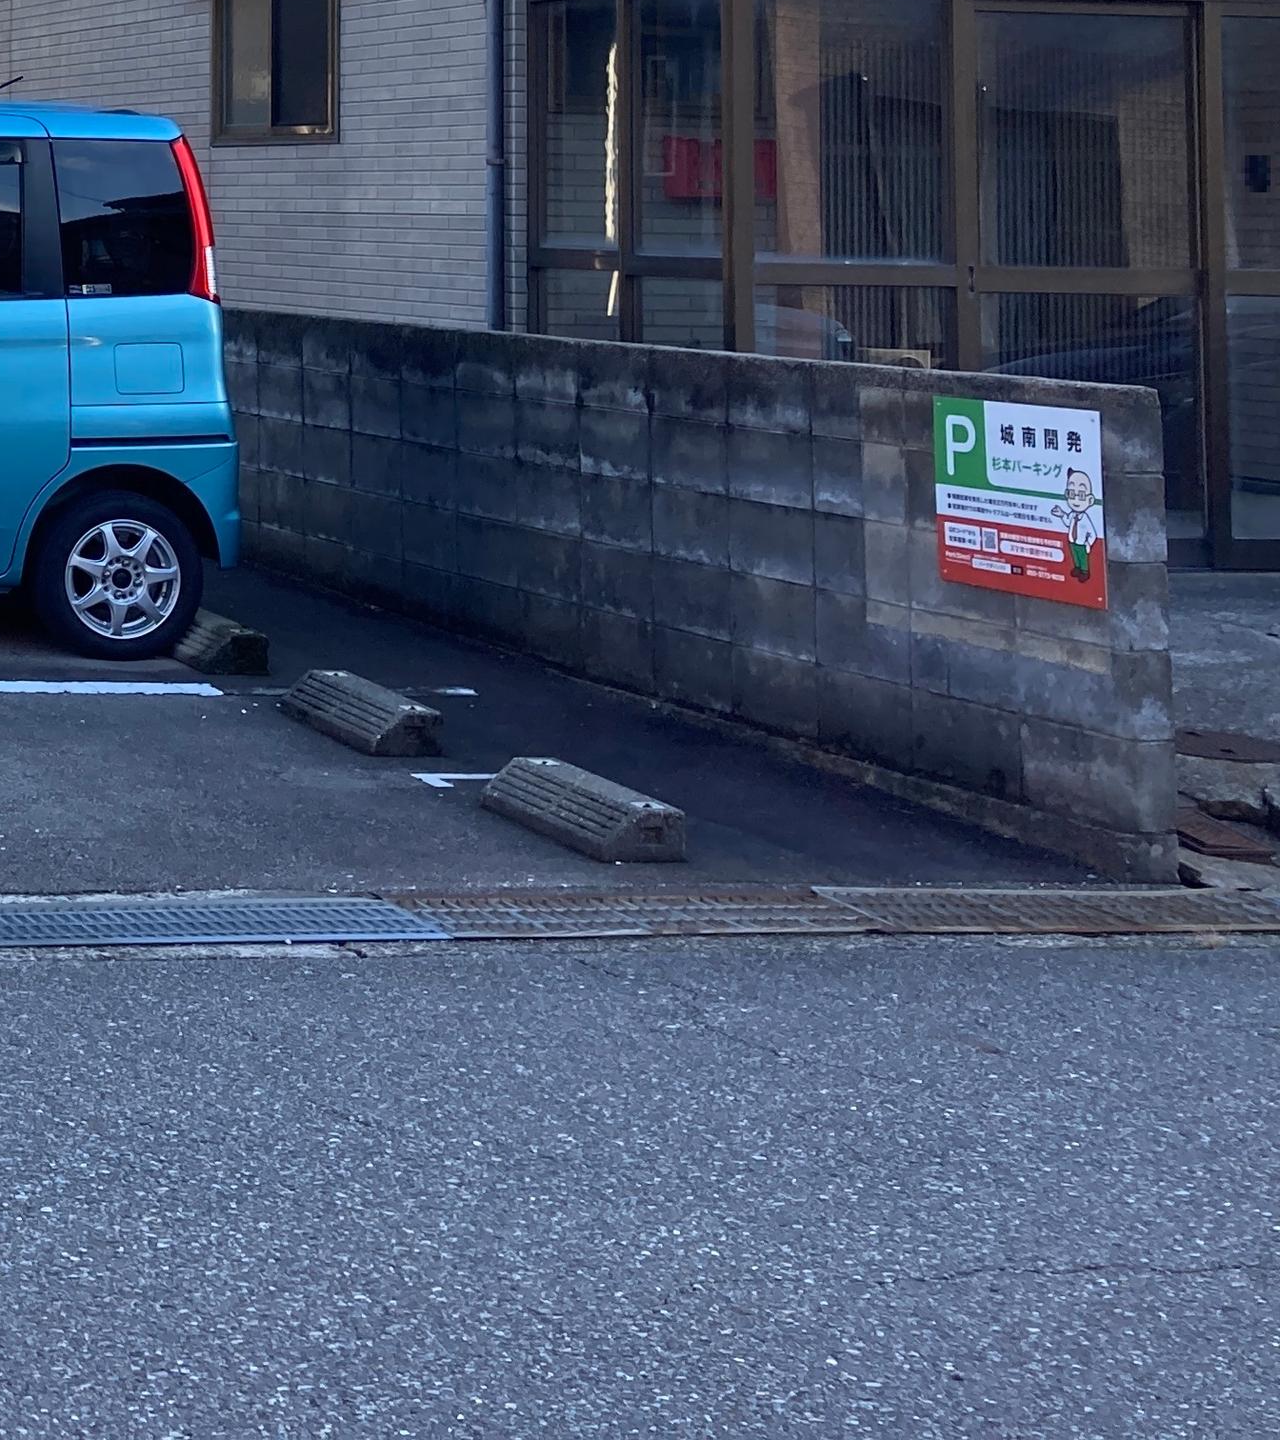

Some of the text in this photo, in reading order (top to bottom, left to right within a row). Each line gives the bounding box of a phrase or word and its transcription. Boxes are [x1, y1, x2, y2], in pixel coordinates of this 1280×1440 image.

[945, 414, 976, 475] P
[1000, 424, 1082, 452] 城南開発
[992, 456, 1063, 478] 杉本パーキング
